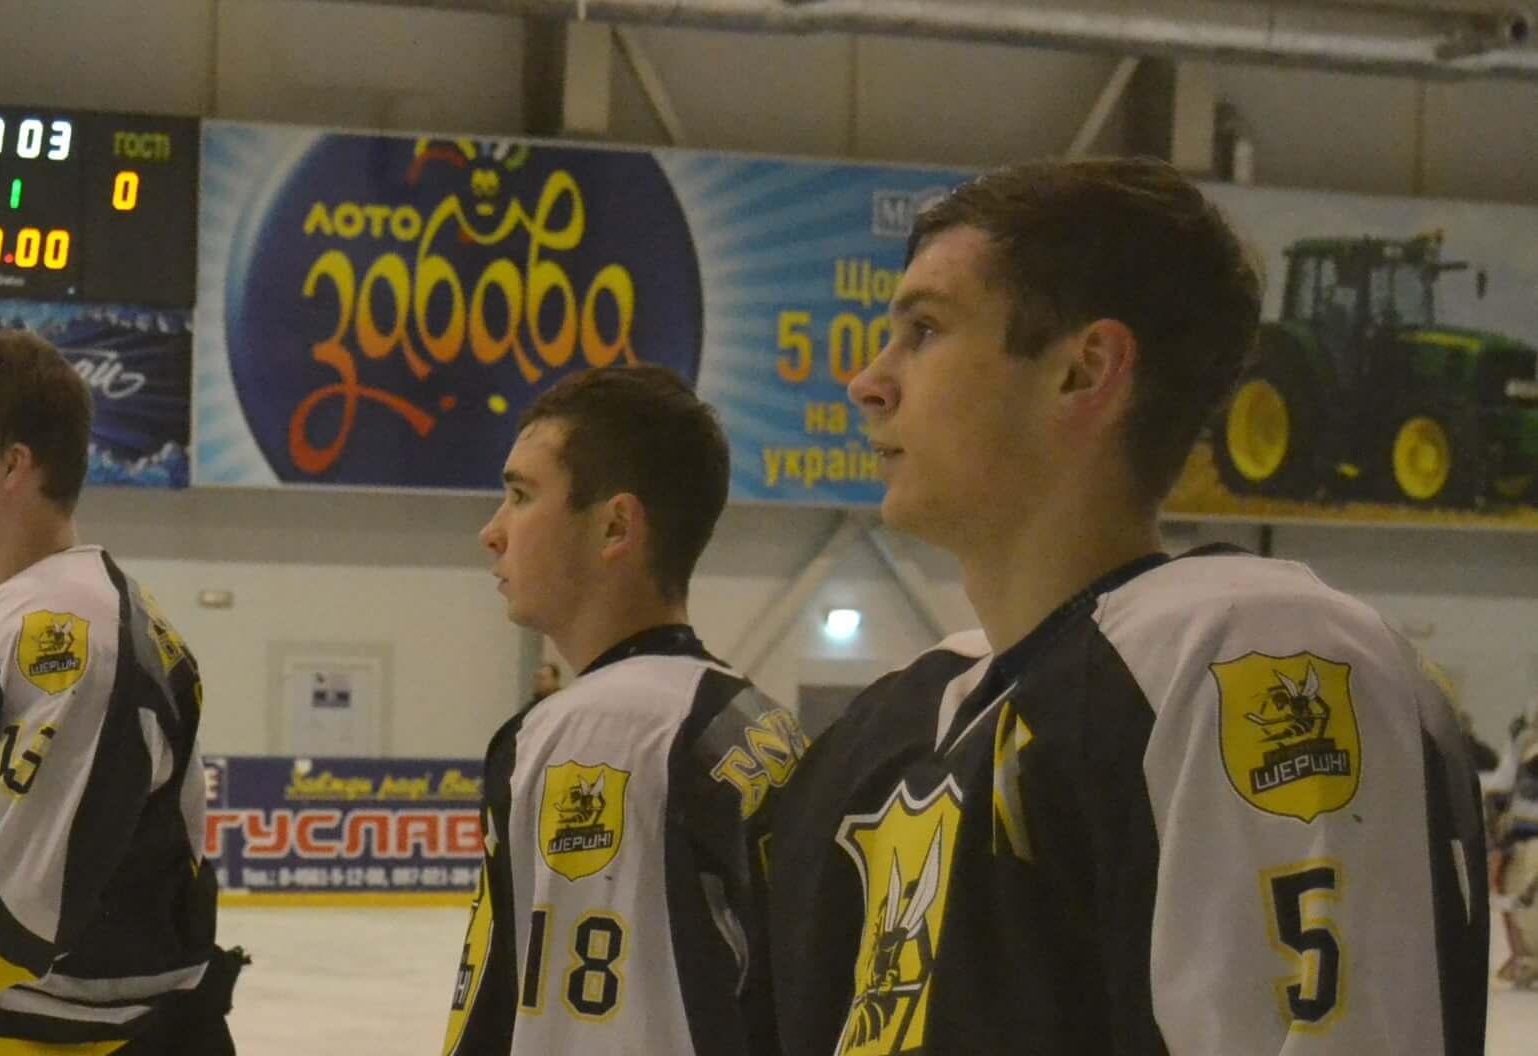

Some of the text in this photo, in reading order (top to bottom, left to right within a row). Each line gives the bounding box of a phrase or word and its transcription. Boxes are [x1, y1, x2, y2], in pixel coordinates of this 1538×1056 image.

[10, 178, 22, 209] 1
[112, 171, 139, 210] 0
[304, 202, 424, 241] ЛОТО
[805, 402, 848, 434] на
[764, 443, 880, 488] україн
[1254, 752, 1348, 790] ШЕРШНІ
[520, 907, 627, 1019] 18
[1266, 860, 1343, 1030] 5
